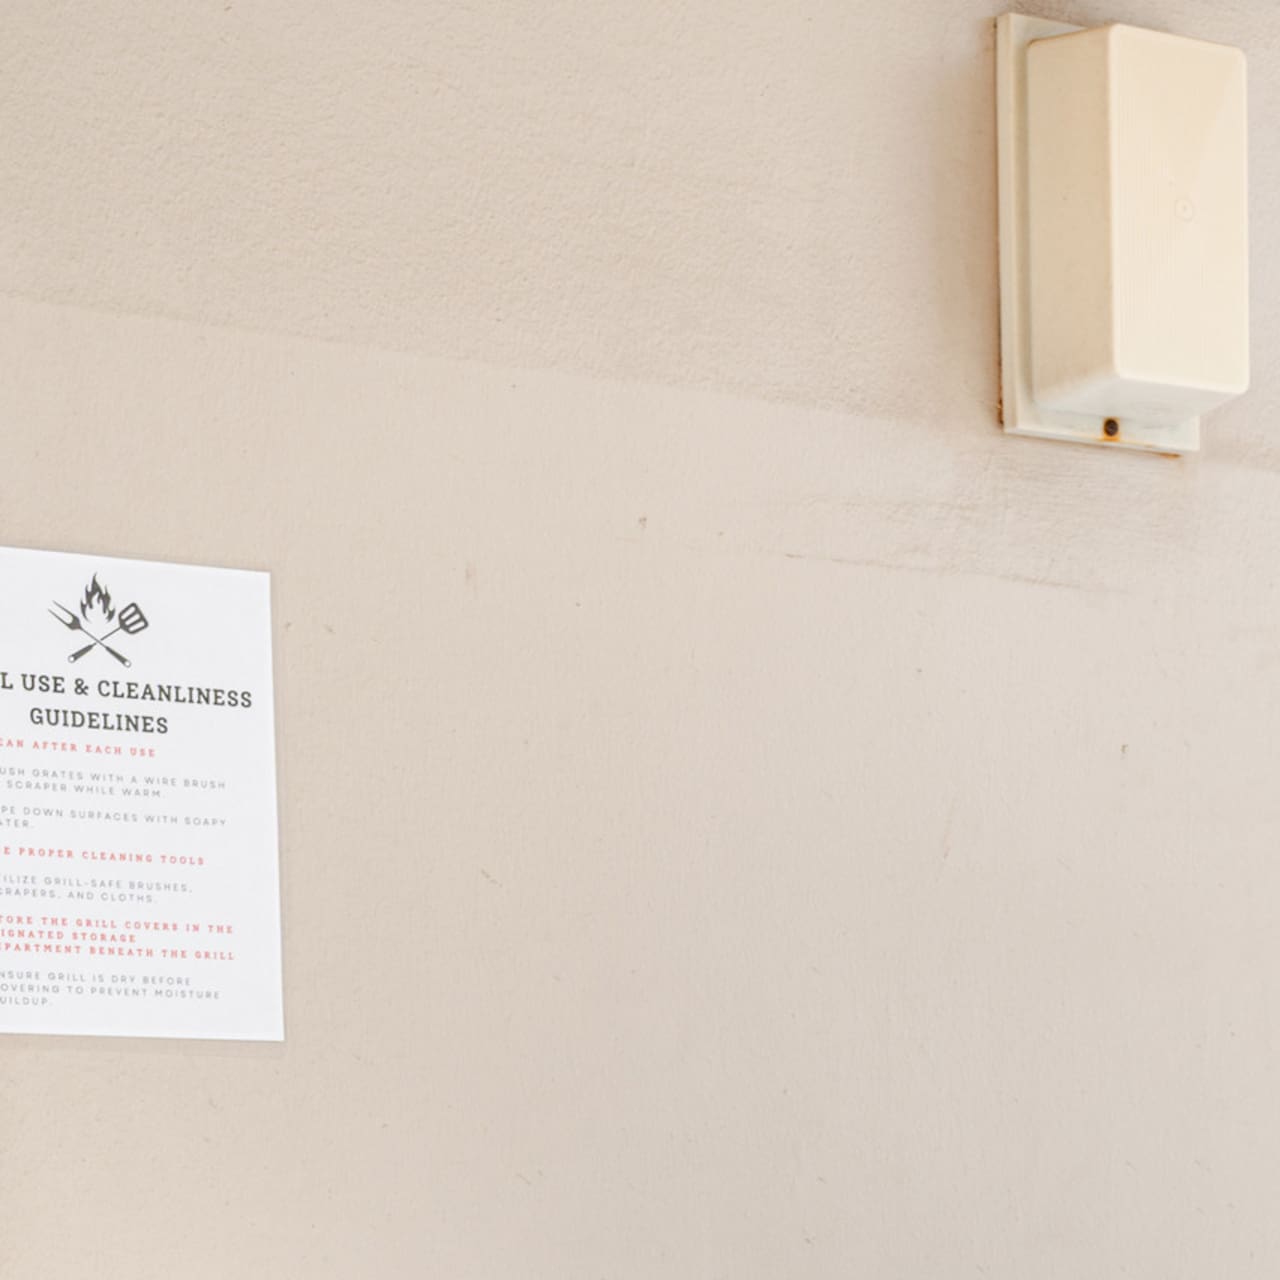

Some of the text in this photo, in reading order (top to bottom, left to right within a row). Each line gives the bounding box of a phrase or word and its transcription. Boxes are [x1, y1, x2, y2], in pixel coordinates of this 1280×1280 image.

[22, 674, 65, 693] USE
[74, 678, 89, 696] &
[98, 680, 253, 707] CLEANLINESS
[30, 708, 169, 733] GUIDELINES
[32, 741, 78, 752] AFTER
[86, 744, 122, 755] EACH
[130, 748, 156, 757] USE
[32, 769, 84, 780] GRATES
[91, 773, 124, 782] WITH
[131, 775, 137, 783] A
[144, 776, 177, 786] WIRE
[184, 778, 226, 789] BRUSH
[7, 780, 67, 792] SCRAPER
[74, 785, 115, 795] WHILE
[24, 807, 63, 817] DOWN
[70, 810, 138, 823] SURFACES
[145, 814, 177, 824] WITH
[184, 817, 226, 827] SOAPY
[19, 847, 74, 858] PROPER
[82, 851, 153, 863] CLEANING
[160, 855, 205, 865] TOOLS
[44, 876, 123, 889] GRILL-SAFE
[67, 891, 95, 901] AND
[100, 893, 157, 903] CLOTHS.
[41, 917, 68, 926] THE
[76, 919, 117, 929] GRILL
[125, 921, 178, 931] COVERS
[186, 923, 199, 932] IN
[208, 924, 233, 934] THE
[72, 932, 136, 943] STORAGE
[89, 946, 154, 957] BENEATH
[162, 949, 188, 959] THE
[195, 950, 235, 961] GRILL
[48, 972, 87, 982] GRILL
[92, 974, 105, 983] IS
[111, 974, 136, 984] DRY
[143, 976, 191, 986] BEFORE
[67, 985, 83, 995] TO
[91, 986, 148, 997] PREVENT
[155, 989, 220, 999] MOISTURE
